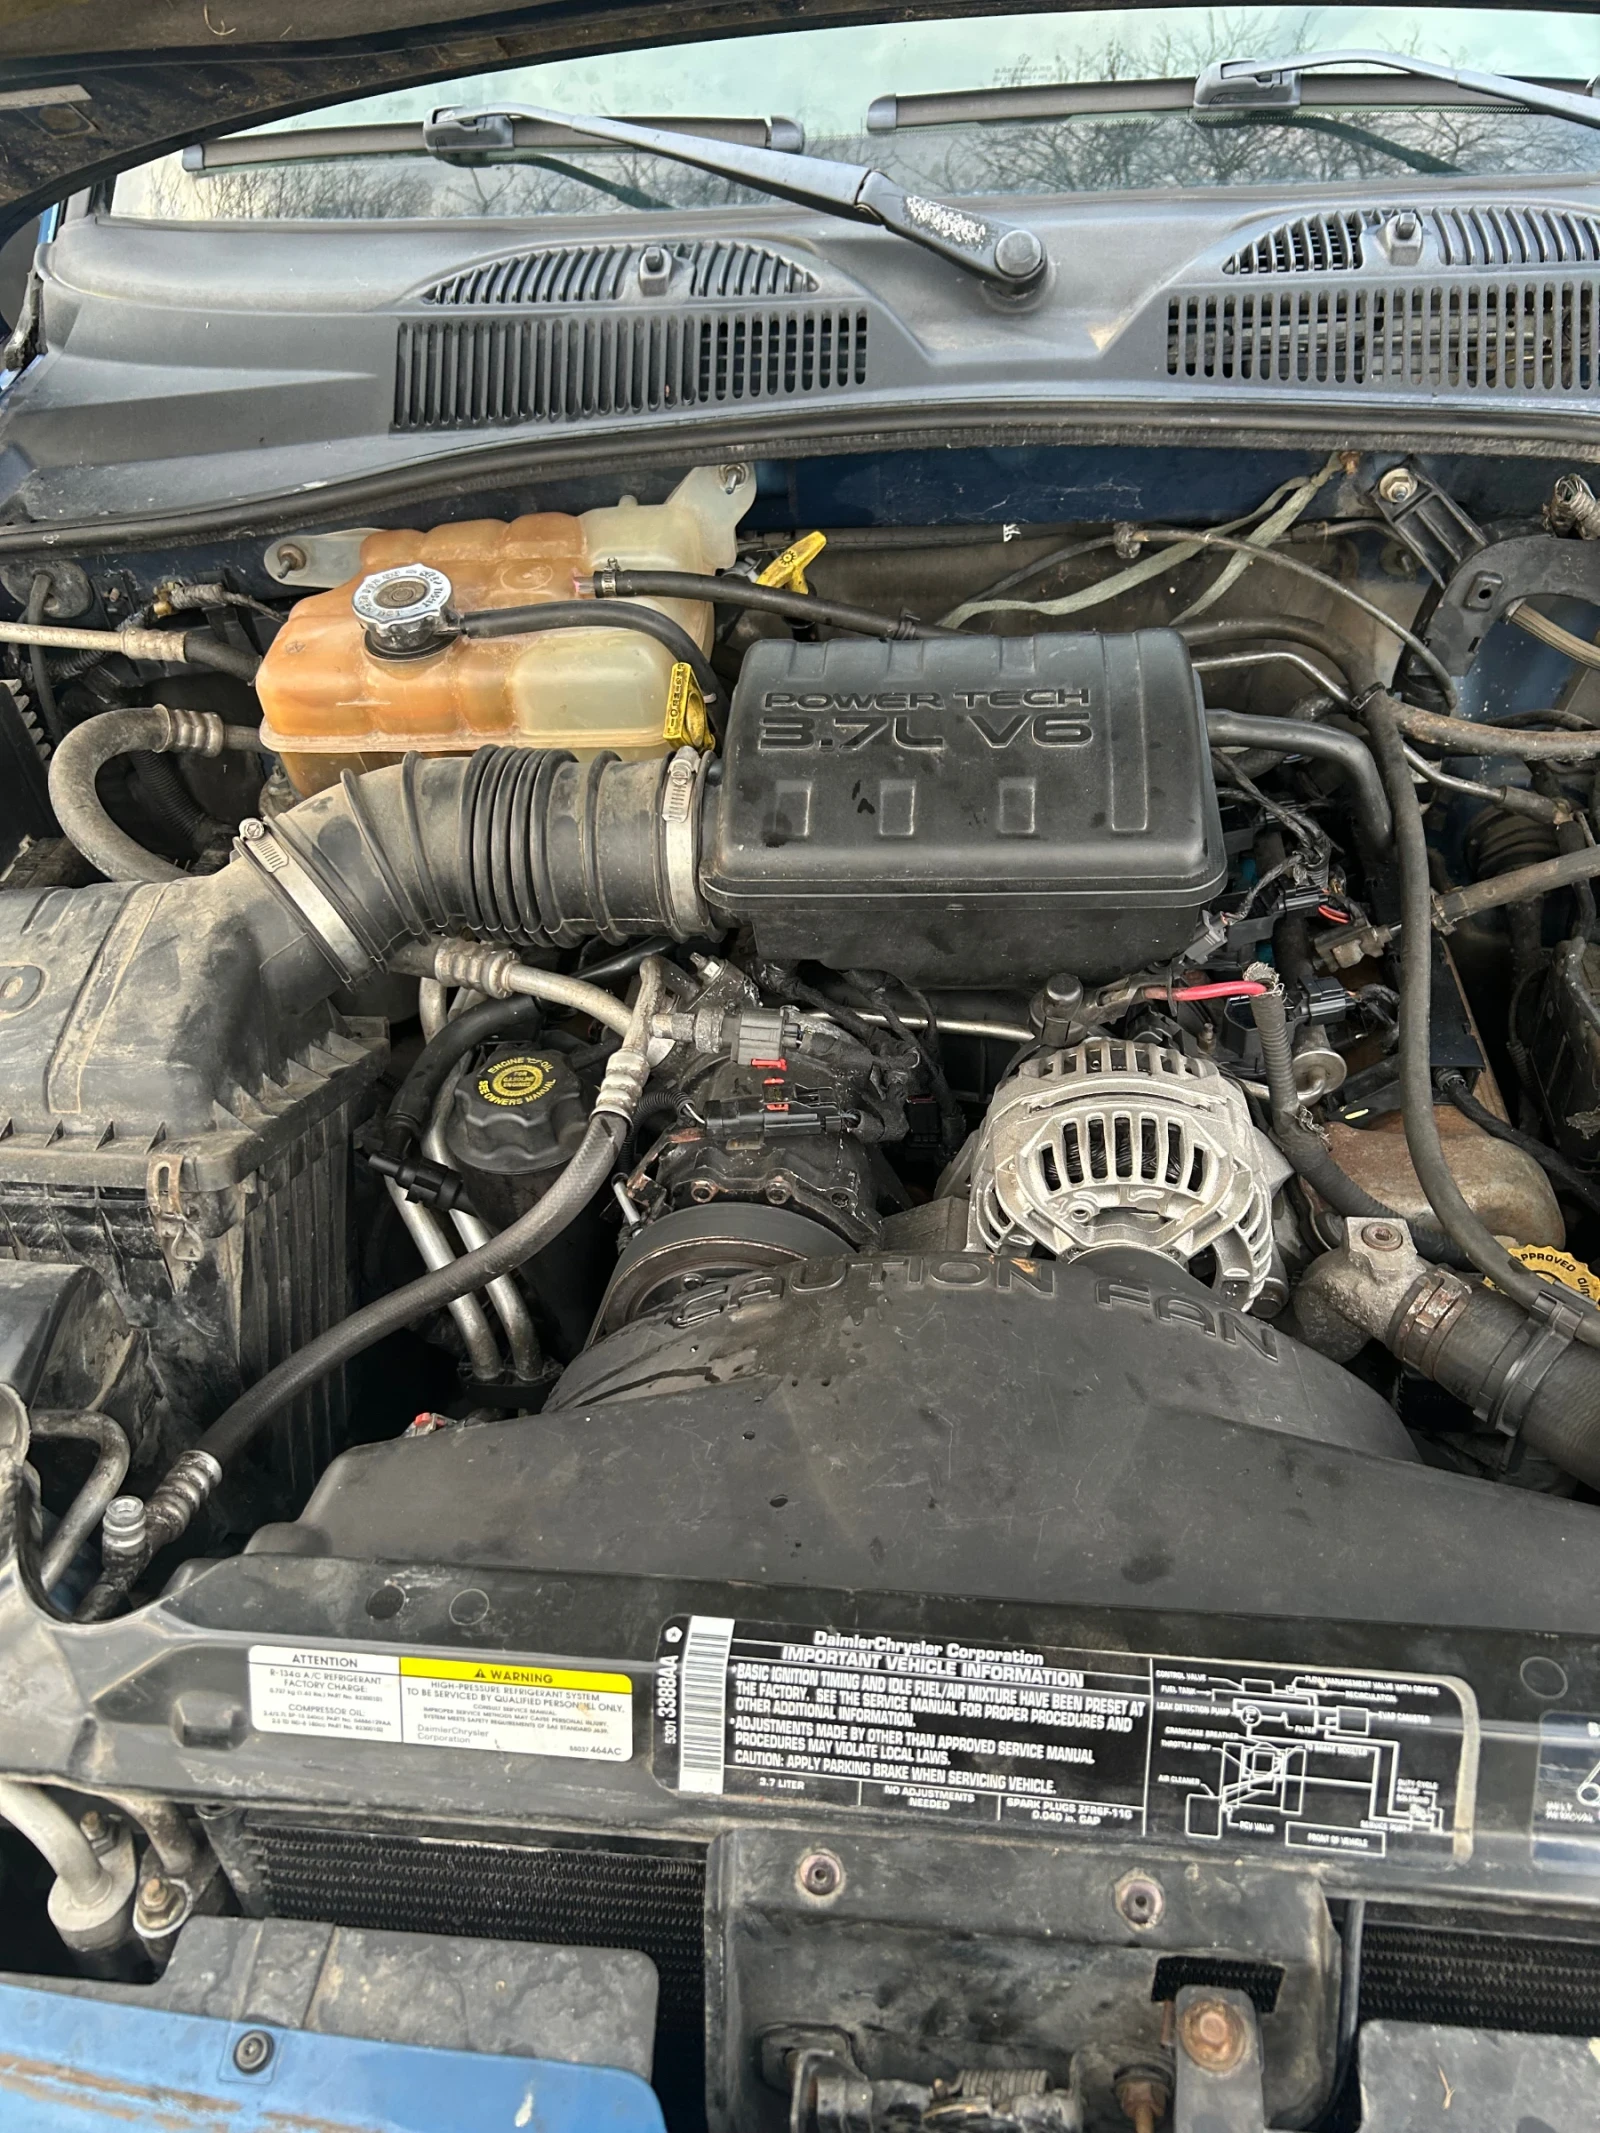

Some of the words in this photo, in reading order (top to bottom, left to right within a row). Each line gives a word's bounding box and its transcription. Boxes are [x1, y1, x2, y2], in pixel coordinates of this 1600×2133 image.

[764, 692, 945, 712] POWER
[952, 688, 1091, 709] TECH
[758, 715, 946, 752] 3.7L
[967, 712, 1094, 748] V6
[487, 1057, 525, 1074] ENGINE
[541, 1061, 554, 1073] OIL
[478, 1080, 491, 1095] SEE
[525, 1079, 557, 1103] MANUAL
[1519, 1253, 1576, 1272] PPROVED
[1577, 1277, 1590, 1298] UID
[672, 1256, 1057, 1328] CAUTION
[1096, 1278, 1278, 1363] FAN
[814, 1630, 943, 1655] DaimlerChrysler
[946, 1642, 1044, 1666] Corporation
[292, 1654, 358, 1668] ATTENTION
[783, 1646, 881, 1668] IMPORTANT
[884, 1655, 956, 1675] VEHICLE
[960, 1662, 1084, 1687] INFORMATION
[284, 1679, 324, 1689] FACTORY
[324, 1672, 381, 1684] REFRIGERANT
[491, 1670, 553, 1683] WARNING
[657, 1655, 680, 1718] 3388AA
[407, 1687, 419, 1695] TO
[421, 1688, 431, 1696] BE
[434, 1689, 477, 1700] SERVICED
[480, 1693, 491, 1701] BY
[494, 1694, 541, 1705] QUALIFIED
[543, 1698, 595, 1710] PERSONEL
[431, 1680, 500, 1693] HIGH-PRESSURE
[503, 1686, 562, 1698] REFRIGERANT
[566, 1691, 600, 1701] SYSTEM
[737, 1664, 769, 1682] BASIC
[769, 1667, 818, 1686] IGNITION
[819, 1672, 859, 1690] TIMING
[861, 1676, 886, 1692] AND
[887, 1678, 912, 1695] IDLE
[913, 1680, 965, 1700] FUEL/AIR
[966, 1685, 1016, 1704] MIXTURE
[1018, 1690, 1049, 1707] HAVE
[1050, 1693, 1082, 1710] BEEN
[1084, 1696, 1127, 1714] PRESET
[1129, 1700, 1145, 1716] AT
[288, 1704, 346, 1715] COMPRESSOR
[736, 1680, 757, 1696] THE
[757, 1682, 810, 1701] FACTORY.
[814, 1688, 837, 1704] SEE
[838, 1690, 860, 1706] THE
[861, 1692, 908, 1711] SERVICE
[909, 1696, 958, 1715] MANUAL
[958, 1701, 982, 1718] FOR
[983, 1704, 1028, 1722] PROPER
[1030, 1708, 1104, 1729] PROCEDURES
[1106, 1715, 1133, 1732] AND
[736, 1697, 771, 1714] OTHER
[771, 1700, 836, 1719] ADDITIONAL
[837, 1706, 916, 1726] INFORMATION.
[417, 1724, 488, 1738] DaimlerChrysler
[417, 1732, 471, 1744] Corporation
[664, 1720, 677, 1745] 5301
[735, 1716, 814, 1737] ADJUSTMENTS
[814, 1723, 847, 1740] MADE
[848, 1726, 864, 1742] BY
[866, 1728, 903, 1745] OTHER
[904, 1732, 935, 1748] THAN
[936, 1735, 996, 1754] APPROVED
[996, 1740, 1044, 1759] SERVICE
[1045, 1745, 1095, 1763] MANUAL
[735, 1731, 806, 1751] PROCEDURES
[806, 1738, 832, 1753] MAY
[833, 1740, 879, 1758] VIOLATE
[878, 1744, 914, 1761] LOCAL
[915, 1748, 951, 1764] LAWS.
[735, 1749, 784, 1768] CAUTION:
[785, 1754, 820, 1771] APPLY
[822, 1758, 870, 1776] PARKING
[872, 1762, 908, 1780] BRAKE
[910, 1766, 945, 1783] WHEN
[947, 1770, 1006, 1789] SERVICING
[1007, 1775, 1056, 1794] VEHICLE.
[760, 1777, 775, 1787] 3.7
[777, 1778, 804, 1789] LITER
[884, 1785, 900, 1795] NO
[901, 1786, 975, 1802] ADJUSTMENTS
[909, 1797, 950, 1809] NEEDED
[1032, 1810, 1063, 1822] 0.040
[1064, 1813, 1076, 1823] in.
[1078, 1814, 1100, 1825] GAP
